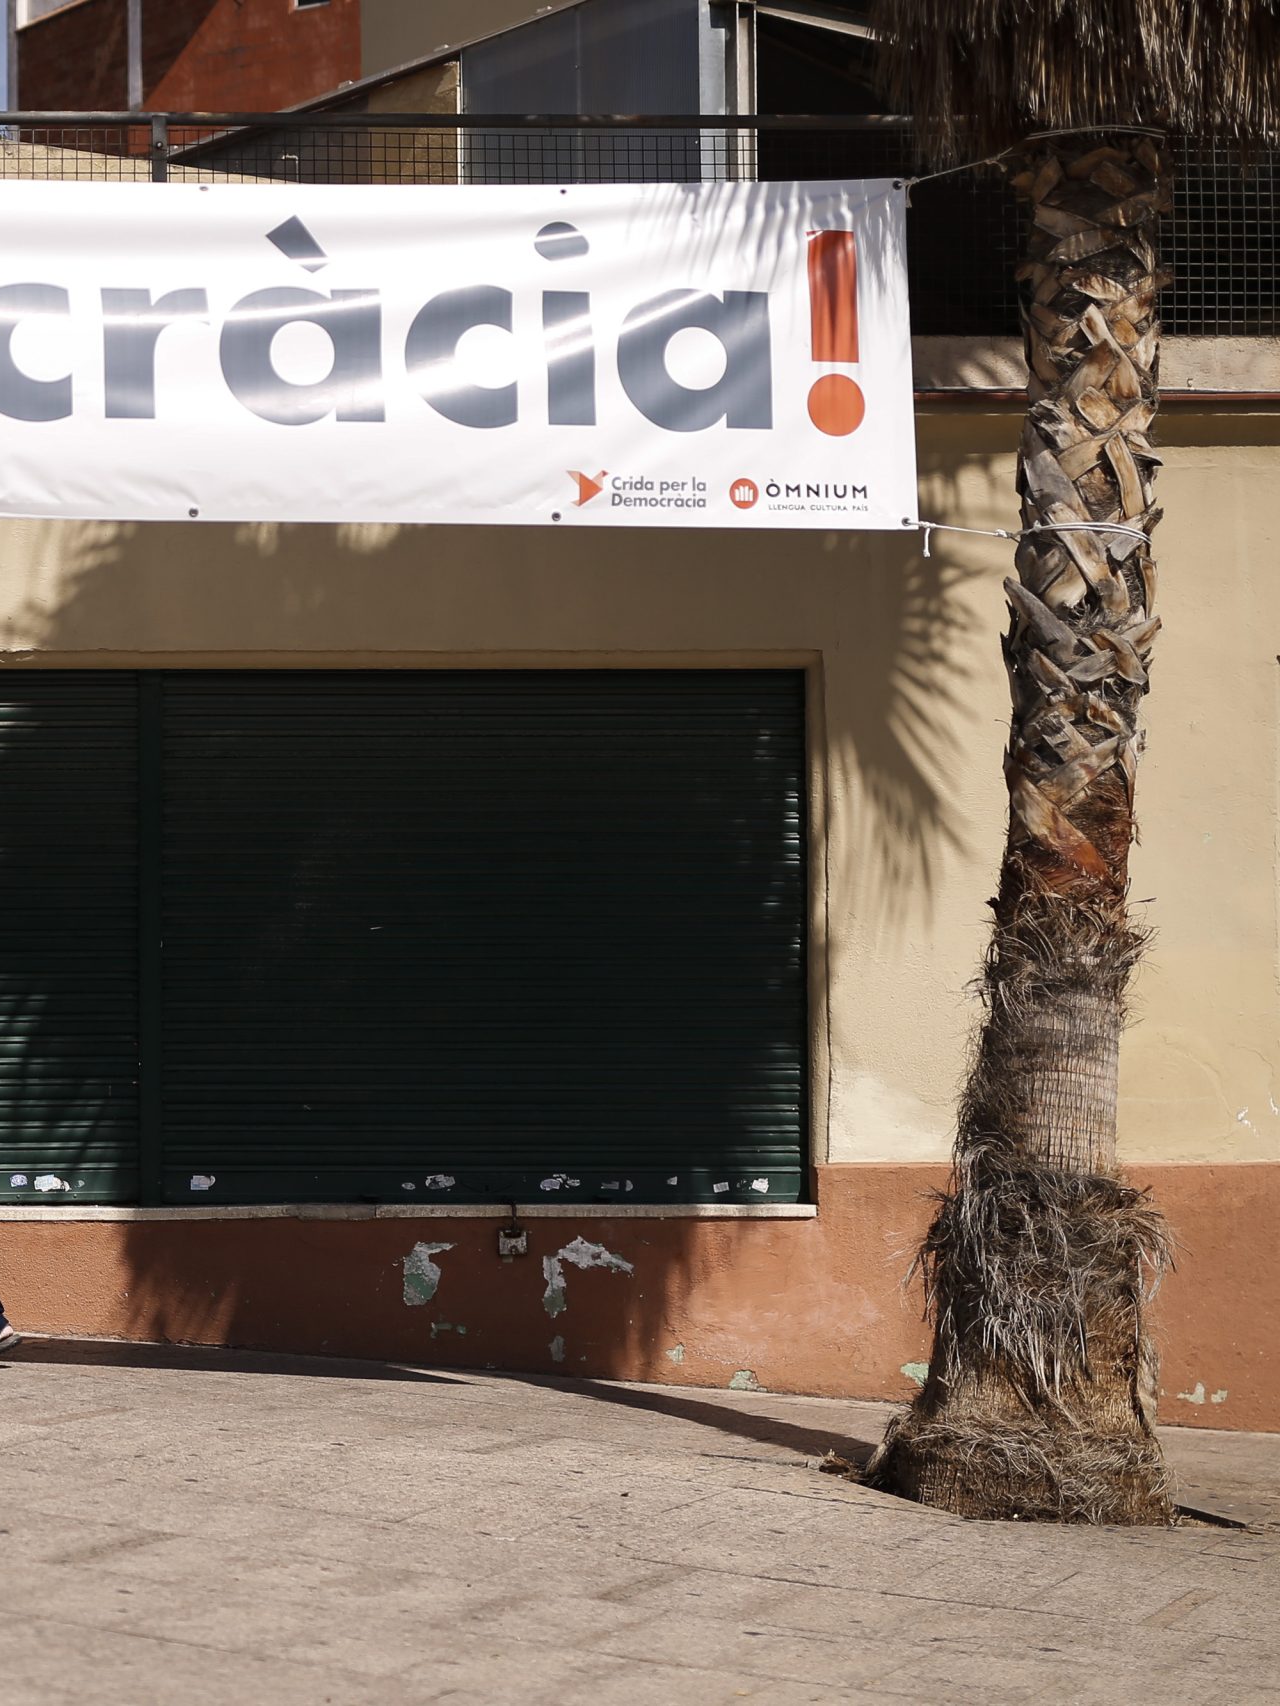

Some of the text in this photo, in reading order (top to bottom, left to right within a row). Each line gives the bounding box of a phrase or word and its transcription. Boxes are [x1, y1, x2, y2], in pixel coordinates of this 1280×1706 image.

[611, 475, 707, 495] Crida per la
[765, 478, 868, 499] ÒMNIUM
[611, 492, 707, 508] Democràcia
[810, 504, 848, 512] CULTURA
[852, 503, 869, 512] PAÍS
